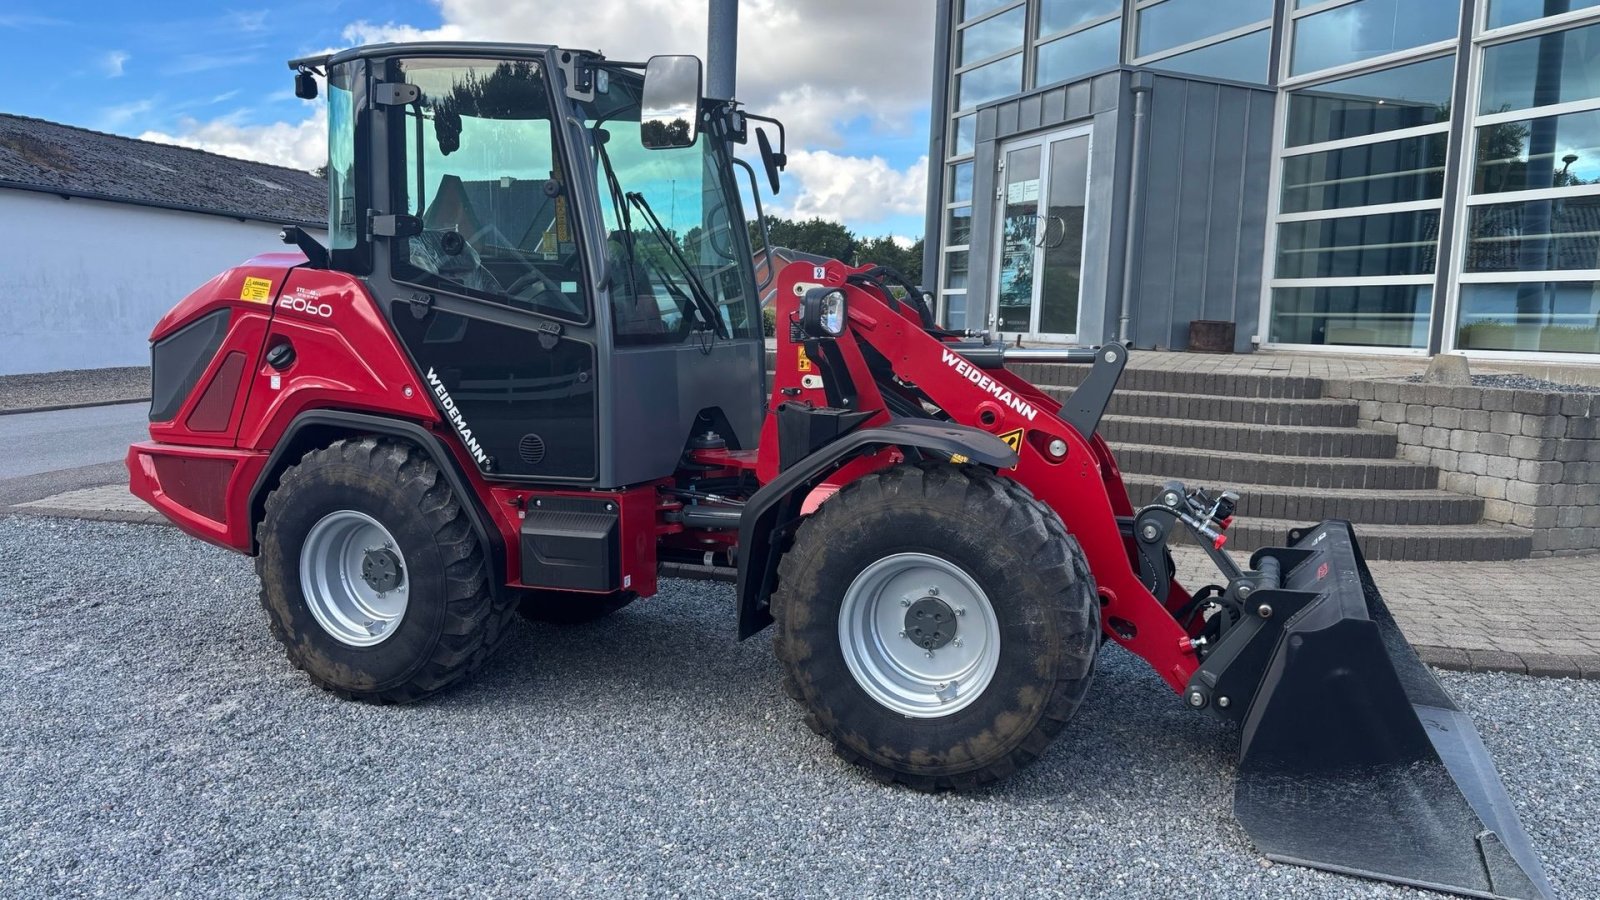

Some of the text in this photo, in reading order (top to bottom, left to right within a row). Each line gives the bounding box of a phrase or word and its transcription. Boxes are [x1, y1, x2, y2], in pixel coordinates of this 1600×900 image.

[280, 294, 333, 318] 2060
[426, 366, 487, 464] WEIDEMANN
[941, 348, 1038, 421] WEIDEMANN
